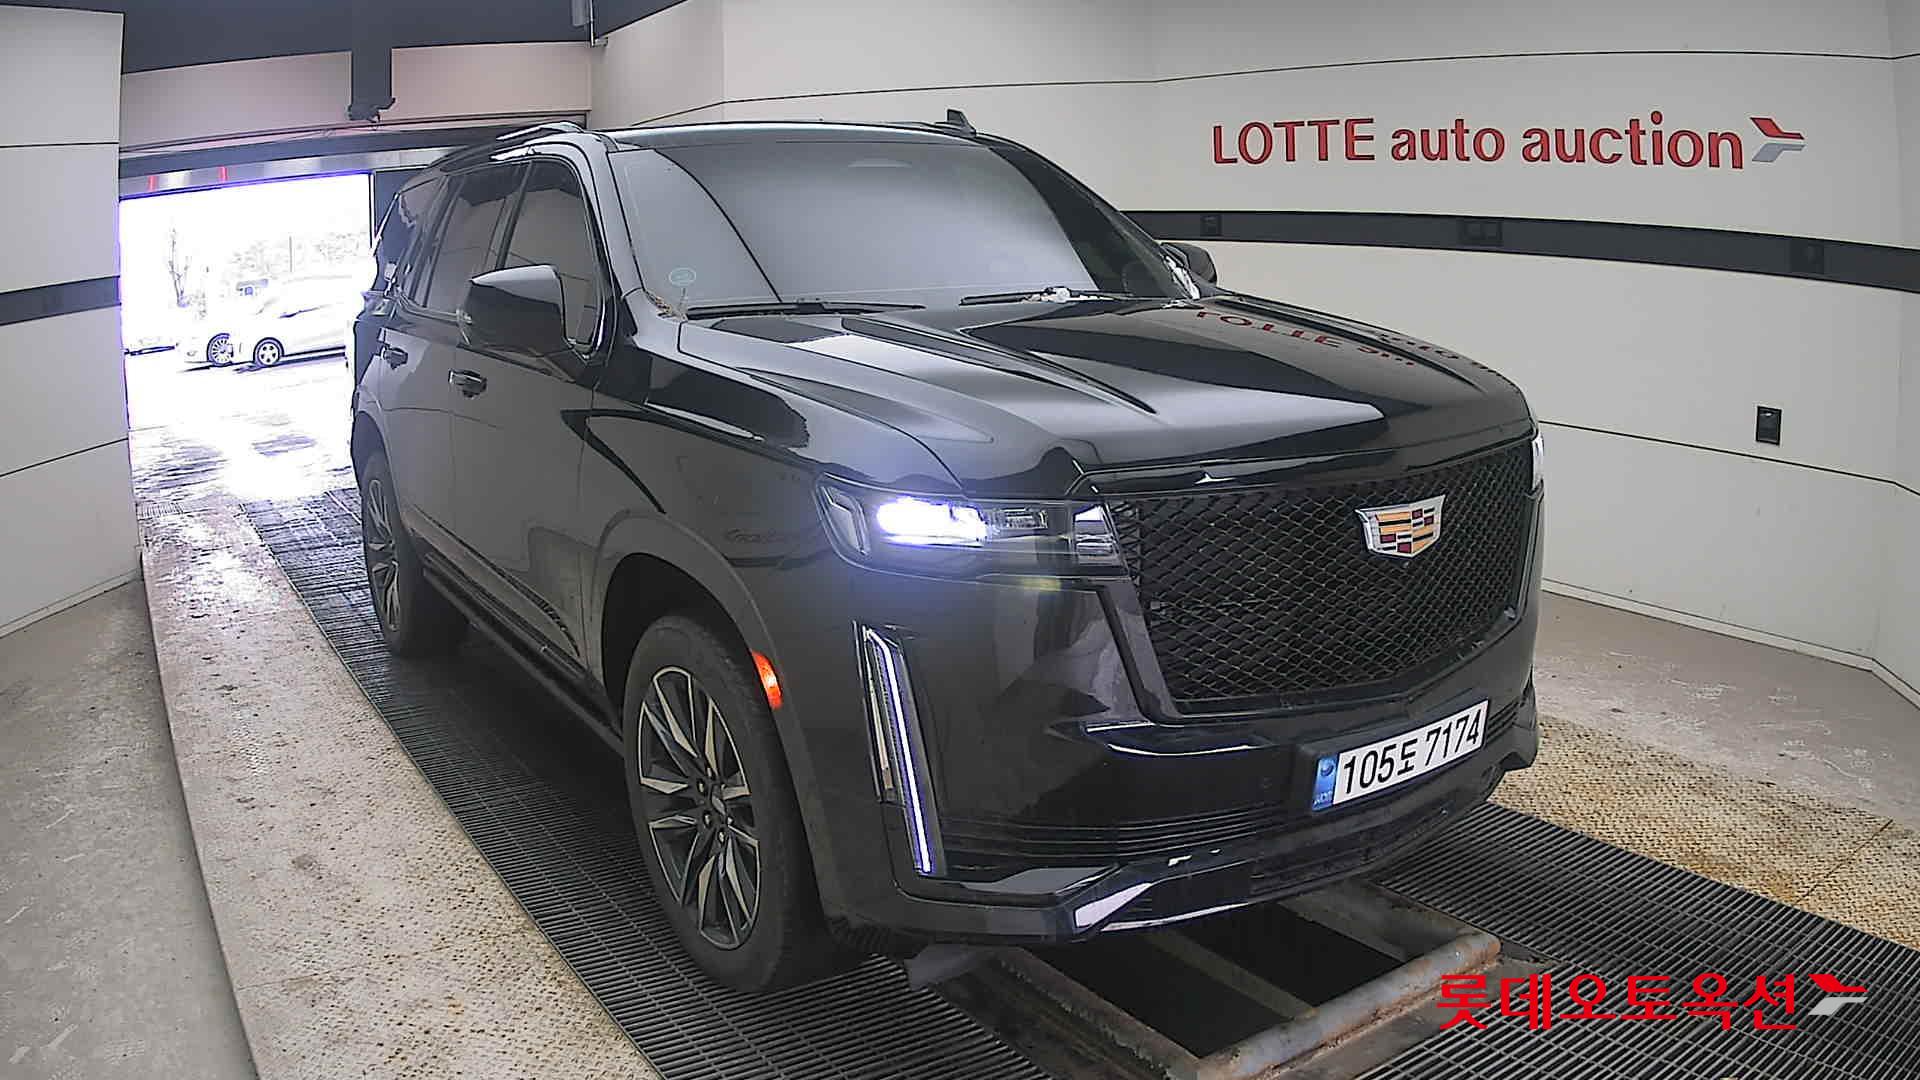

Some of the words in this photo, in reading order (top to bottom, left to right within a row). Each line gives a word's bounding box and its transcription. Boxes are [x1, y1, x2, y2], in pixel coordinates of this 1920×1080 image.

[1212, 117, 1376, 165] LOTTE
[1390, 117, 1506, 164] auto
[1521, 110, 1744, 169] auction
[1343, 738, 1419, 794] 105도
[1424, 709, 1482, 767] 7174
